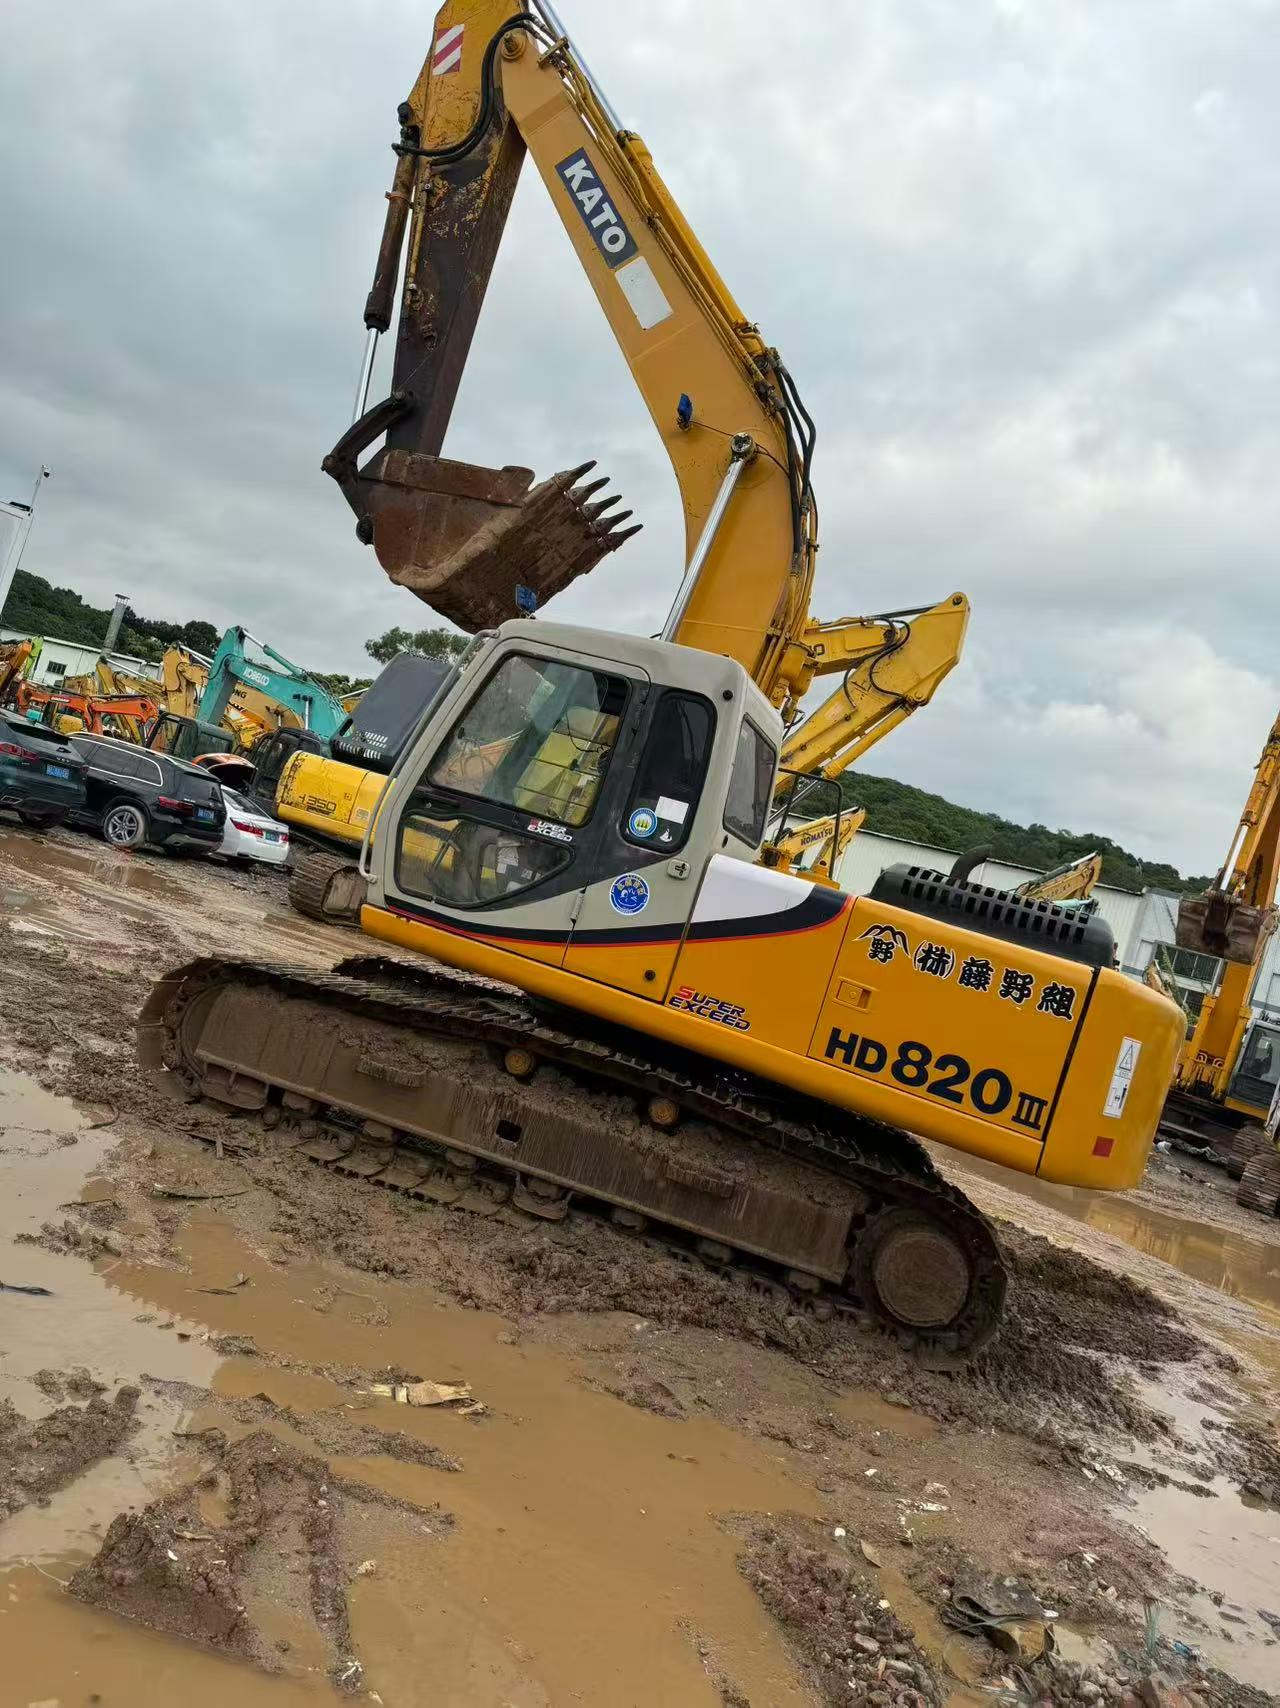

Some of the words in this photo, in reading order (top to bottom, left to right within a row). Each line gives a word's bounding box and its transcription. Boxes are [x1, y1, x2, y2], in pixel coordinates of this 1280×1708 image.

[563, 158, 627, 254] KATO
[527, 824, 573, 842] EXCEED
[530, 817, 567, 832] SUPER
[800, 827, 834, 847] KOMATSU
[668, 996, 752, 1032] EXCEED
[675, 985, 747, 1018] SUPER
